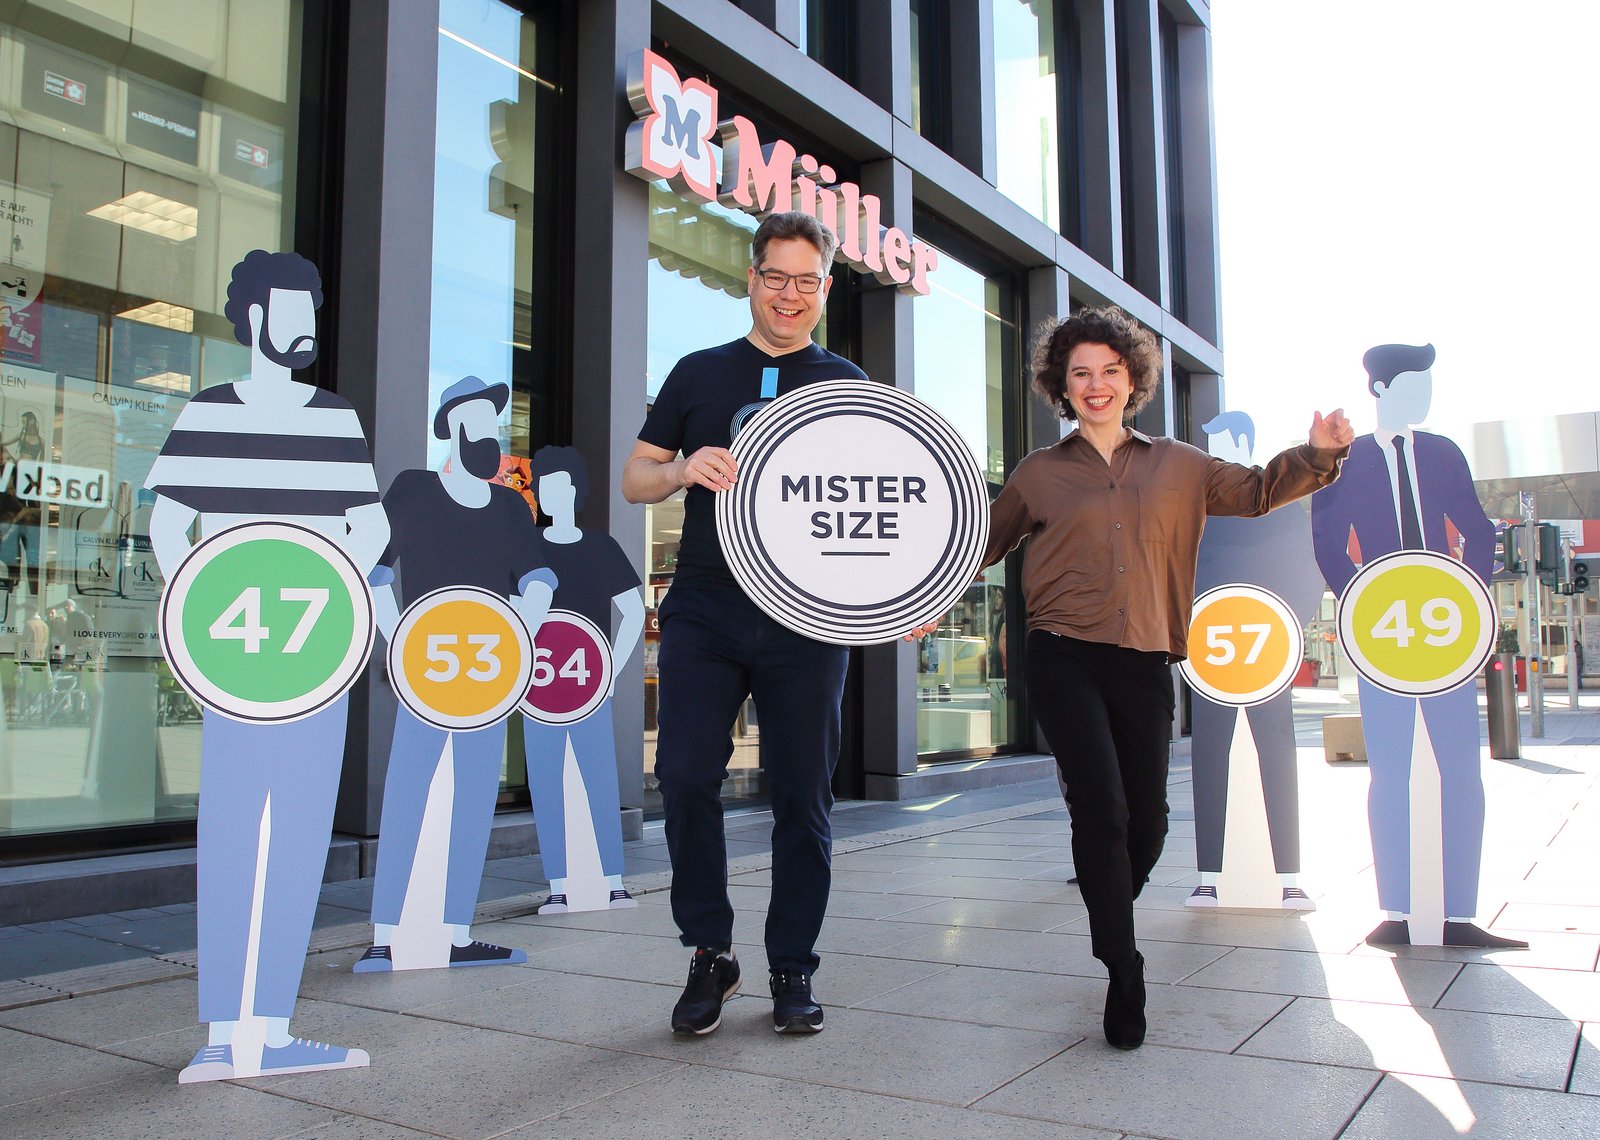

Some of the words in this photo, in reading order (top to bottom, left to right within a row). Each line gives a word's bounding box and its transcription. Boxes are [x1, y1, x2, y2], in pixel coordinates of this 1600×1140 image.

[661, 93, 702, 161] M
[6, 212, 34, 228] ACHT!
[8, 202, 26, 214] AUF
[732, 114, 939, 296] Müller
[0, 373, 27, 390] LEIN
[92, 392, 132, 409] CALVIN
[135, 399, 165, 414] KLEIN
[781, 475, 928, 503] MISTER
[810, 511, 900, 539] SIZE
[208, 587, 330, 654] 47
[1370, 597, 1463, 647] 49
[423, 634, 502, 683] 53
[1204, 623, 1272, 666] 57
[531, 647, 592, 687] 64
